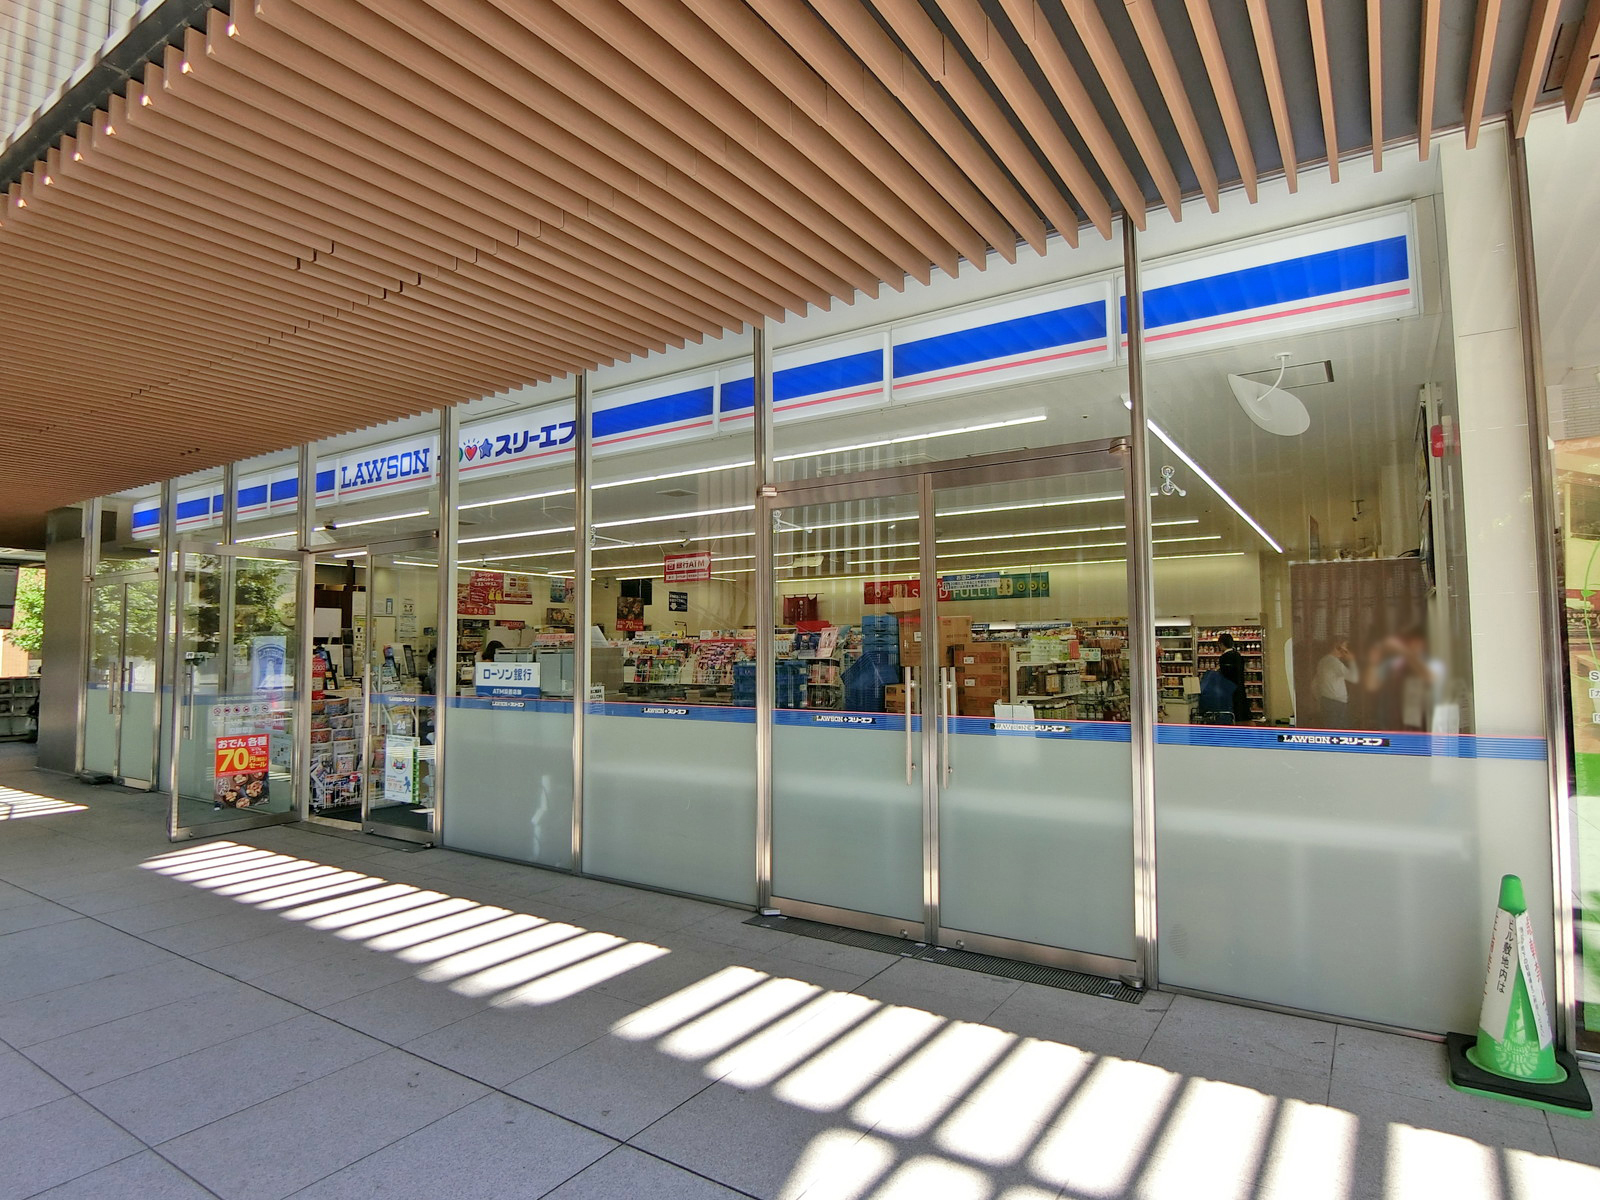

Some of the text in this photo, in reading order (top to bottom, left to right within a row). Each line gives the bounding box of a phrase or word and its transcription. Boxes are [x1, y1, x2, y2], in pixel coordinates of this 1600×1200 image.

[495, 420, 576, 457] スリーエフ
[341, 448, 430, 488] LAWSON
[483, 668, 532, 681] ローソン銀行
[218, 738, 246, 749] おでん
[218, 748, 249, 771] 70
